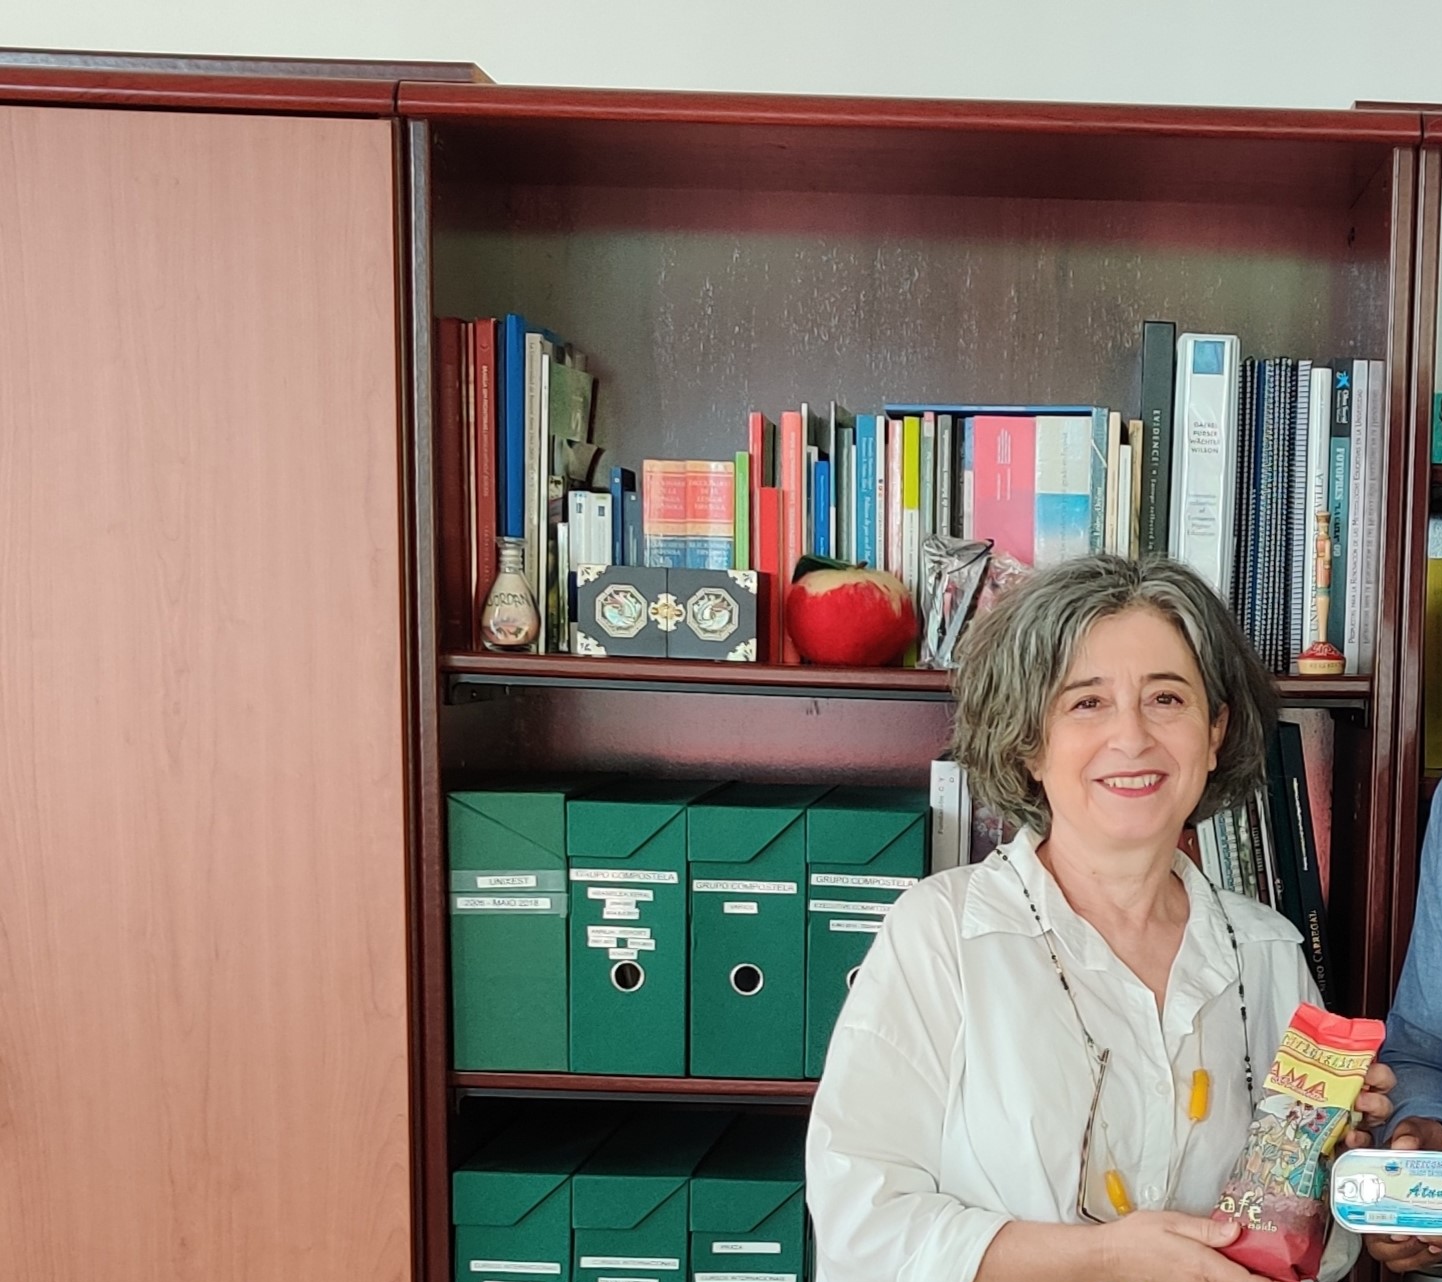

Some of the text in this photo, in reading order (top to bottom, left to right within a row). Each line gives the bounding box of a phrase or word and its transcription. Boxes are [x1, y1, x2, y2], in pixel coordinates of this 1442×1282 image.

[695, 881, 795, 893] GRUPO COMPOSTELA
[815, 875, 915, 888] GRUPO COMPOSTELA
